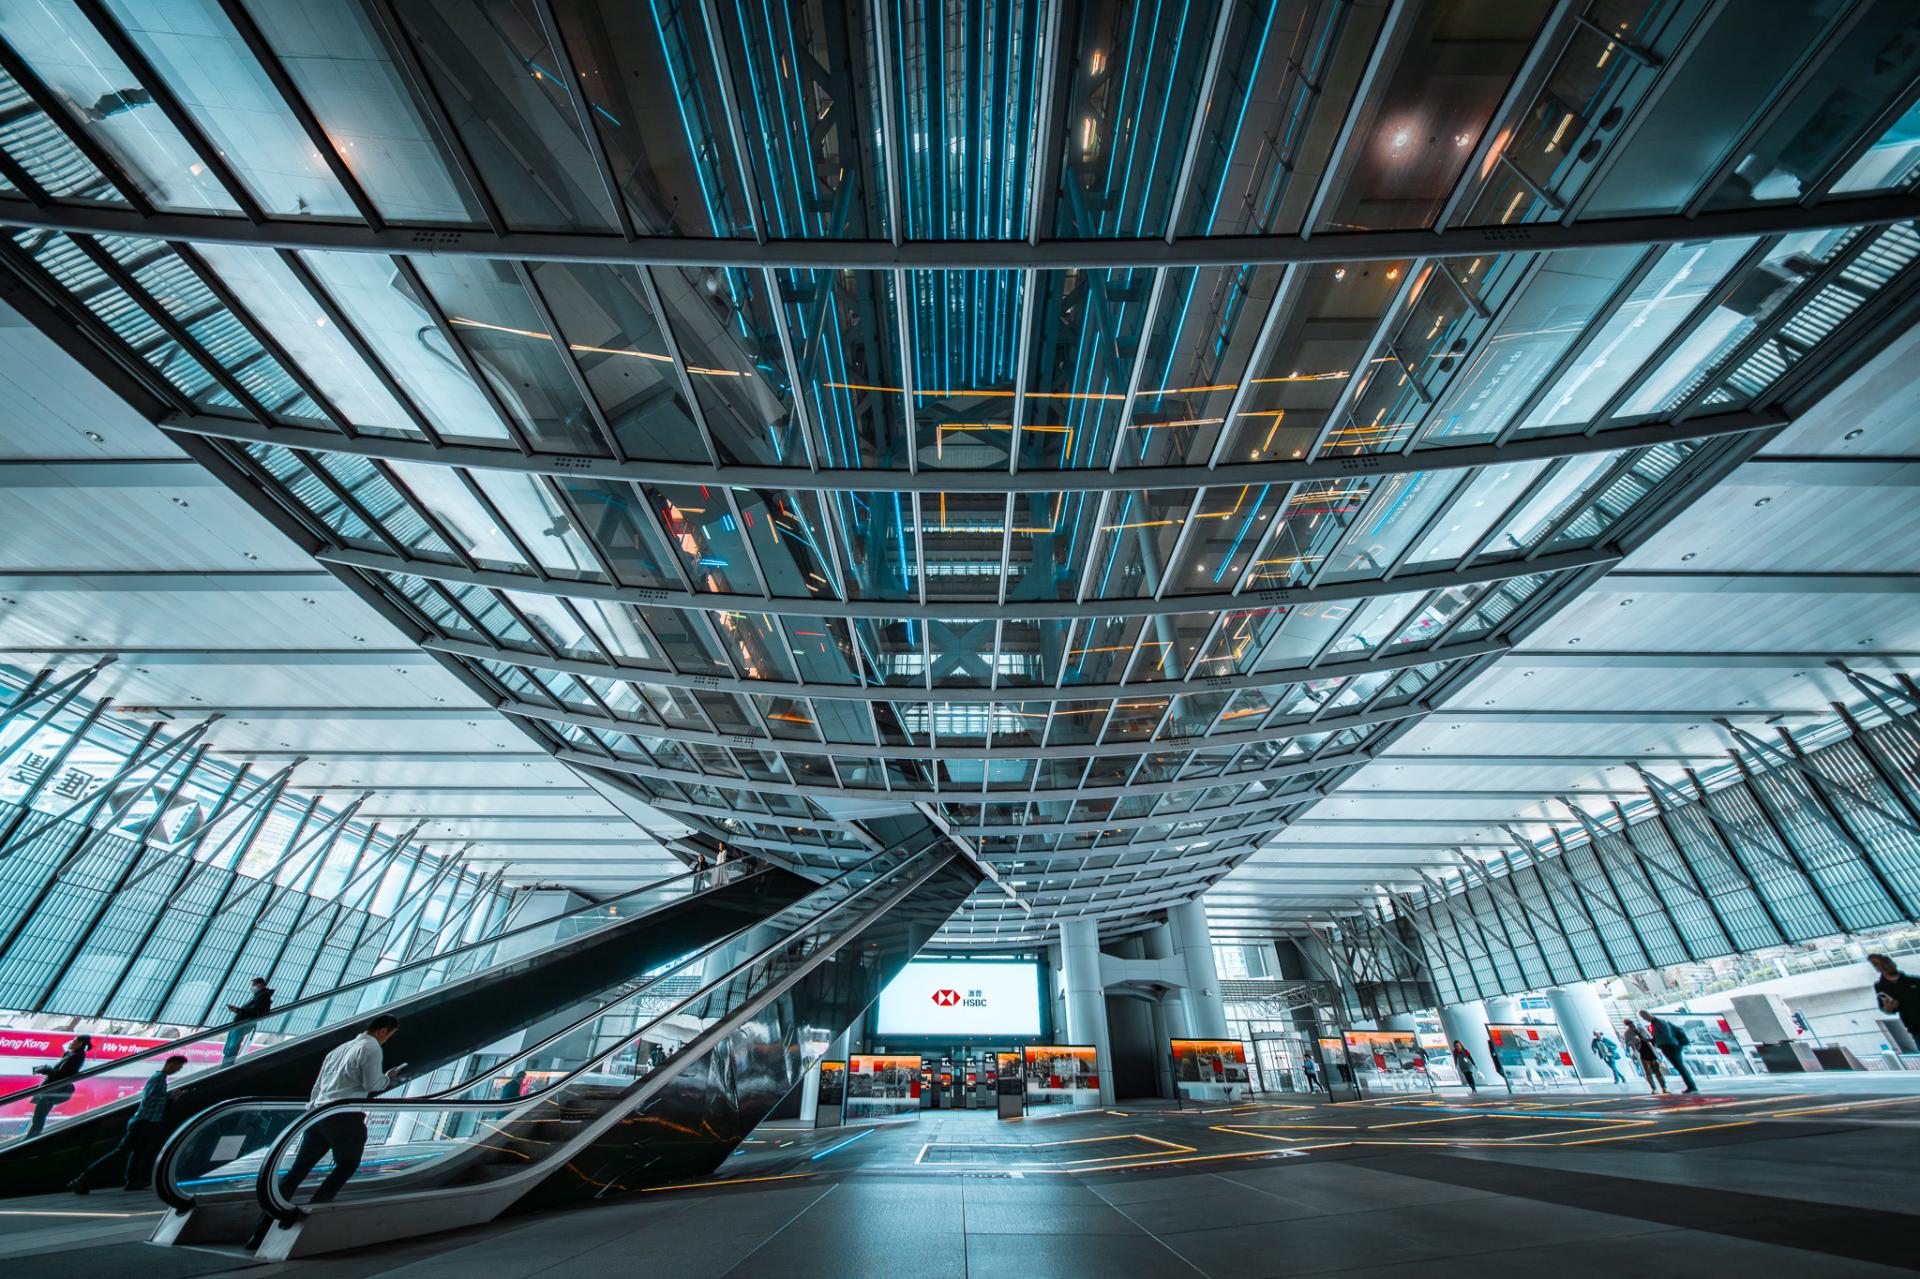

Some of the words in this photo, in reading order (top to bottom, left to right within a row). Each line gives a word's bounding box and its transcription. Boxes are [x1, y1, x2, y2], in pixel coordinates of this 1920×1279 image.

[962, 999, 987, 1007] HSBC
[22, 1038, 50, 1050] Kong
[102, 1042, 127, 1052] We're
